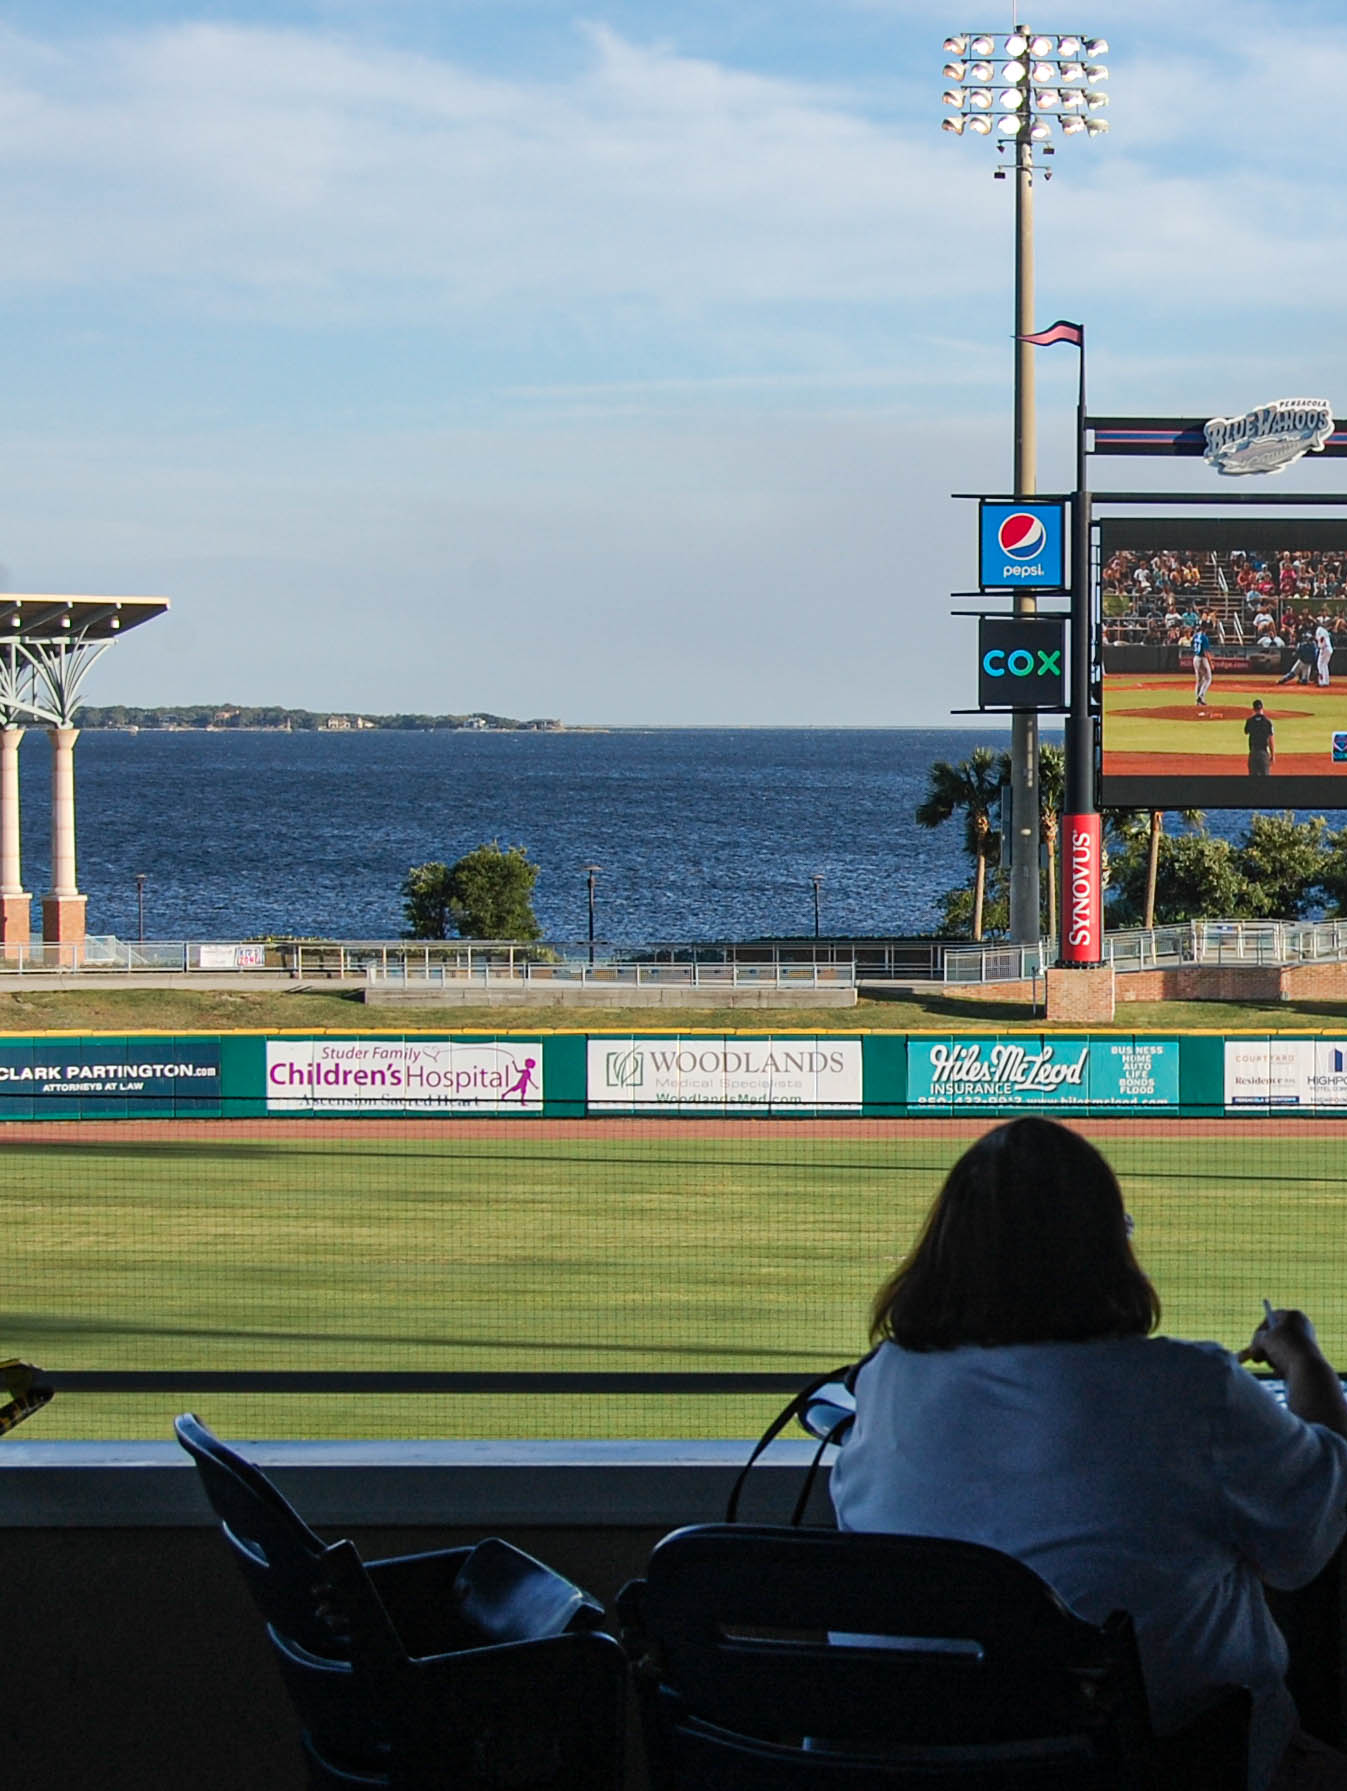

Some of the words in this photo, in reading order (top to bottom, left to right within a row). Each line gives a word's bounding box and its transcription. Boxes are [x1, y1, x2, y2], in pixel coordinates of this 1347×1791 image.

[1280, 400, 1327, 408] PENSACOLA
[1003, 563, 1043, 578] pepsi
[983, 649, 1061, 677] COX
[1069, 832, 1090, 946] SYNOVUS
[322, 1047, 370, 1060] Studer
[372, 1047, 421, 1064] Family
[1122, 1055, 1152, 1063] HOME
[649, 1051, 844, 1073] WOODLANDS
[0, 1067, 61, 1080] CLARK
[67, 1064, 216, 1079] PARTINGTON.com
[270, 1062, 402, 1086] Children's
[407, 1065, 509, 1093] Hospital
[1126, 1070, 1149, 1078] LIFE
[43, 1083, 102, 1092] ATTORNEYS
[120, 1082, 144, 1090] LAW
[655, 1078, 713, 1089] Medical
[1119, 1078, 1155, 1086] BONDS
[930, 1083, 1012, 1094] INSURANCE
[1120, 1086, 1154, 1095] FLOOD
